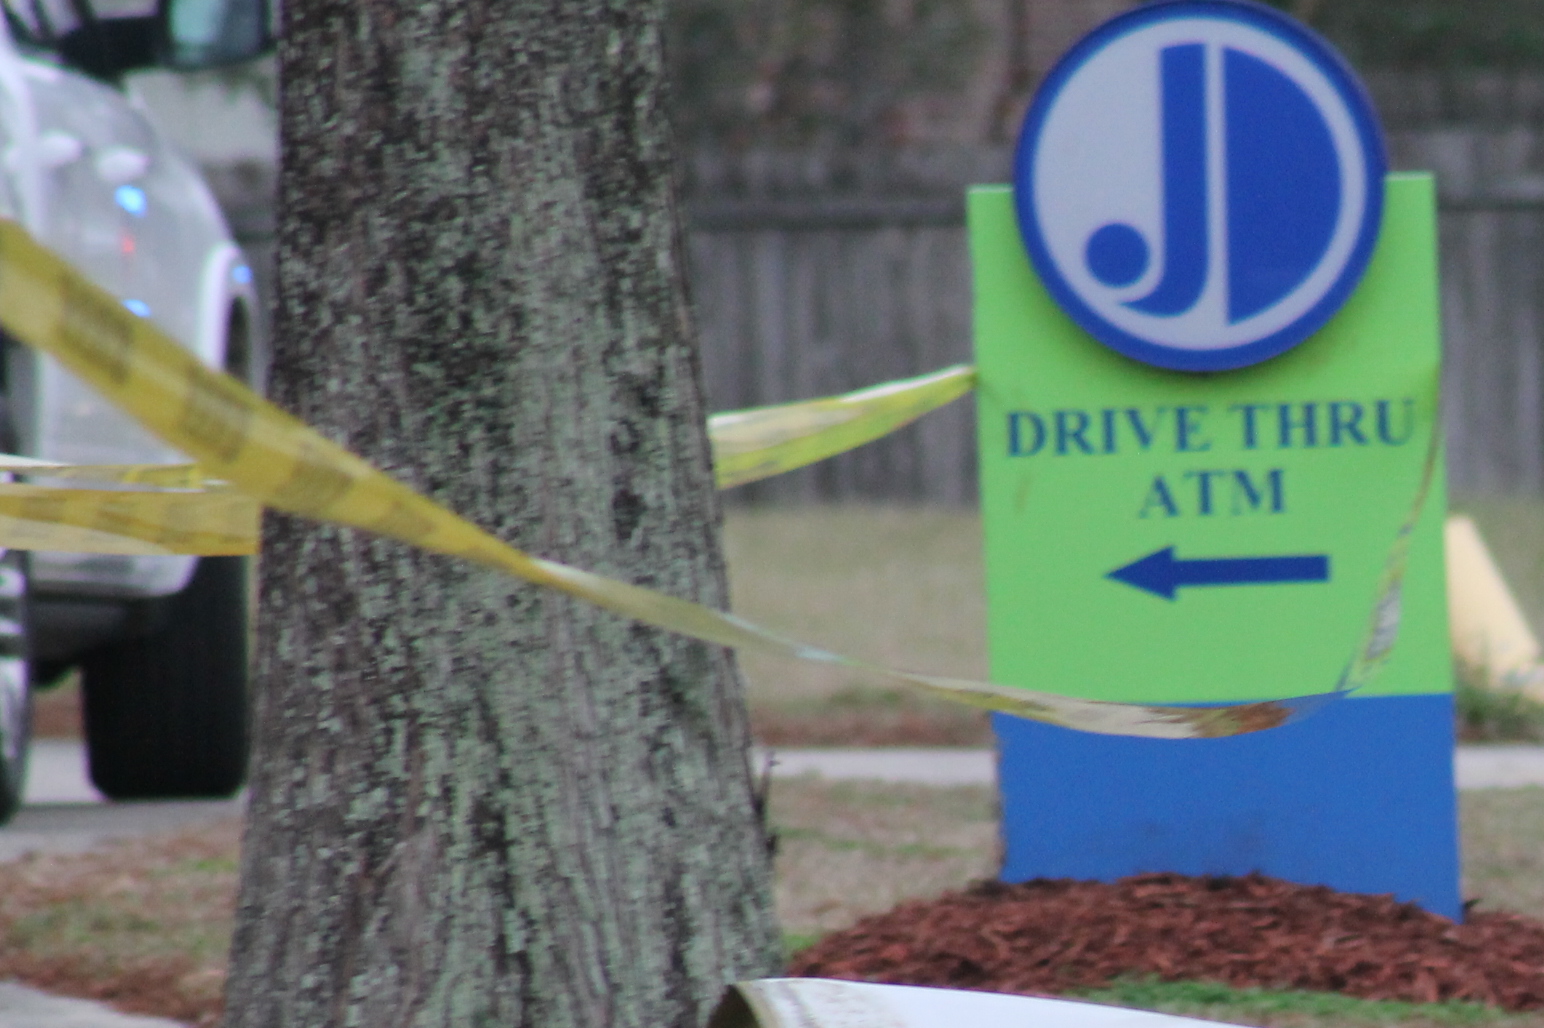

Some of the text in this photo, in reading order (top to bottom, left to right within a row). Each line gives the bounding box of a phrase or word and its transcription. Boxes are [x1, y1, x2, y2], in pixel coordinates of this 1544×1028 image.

[1007, 399, 1416, 457] DRIVE THRU
[1140, 469, 1285, 518] ATM
